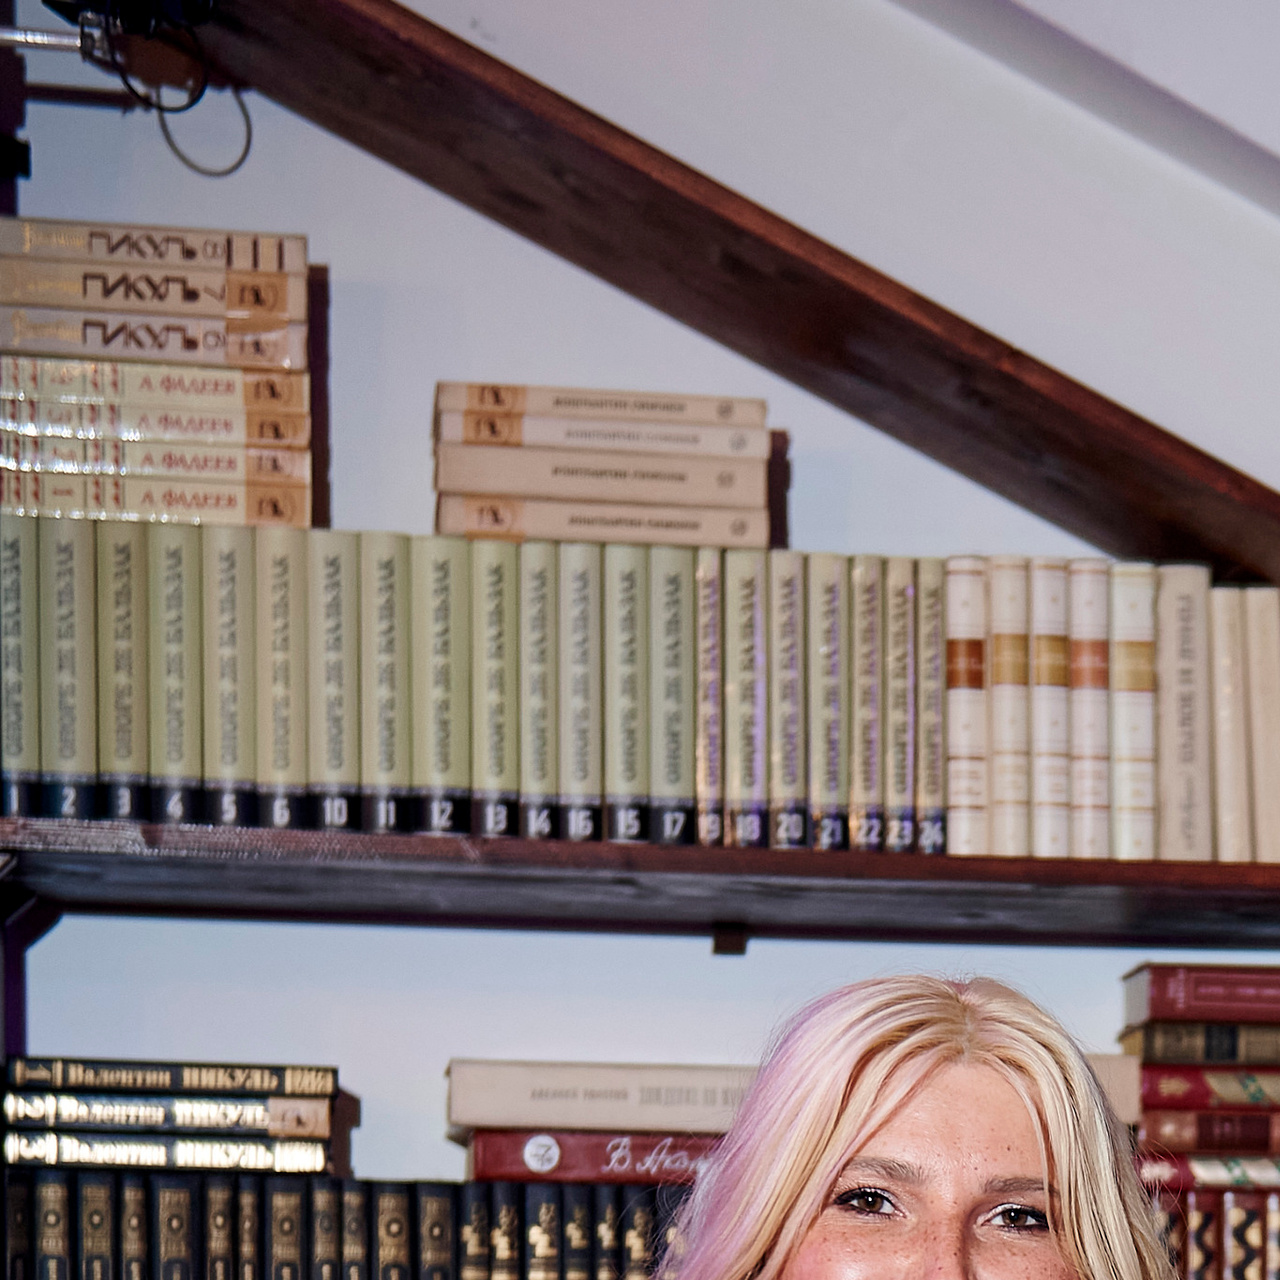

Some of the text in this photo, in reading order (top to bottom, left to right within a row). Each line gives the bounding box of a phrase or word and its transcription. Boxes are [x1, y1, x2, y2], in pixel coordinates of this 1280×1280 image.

[82, 271, 200, 301] ПИКУЛЬ
[82, 319, 200, 351] ПИКУЛЬ
[62, 785, 77, 817] 2
[117, 786, 132, 817] 3
[166, 790, 184, 820] 4
[221, 793, 238, 823] 5
[273, 797, 290, 827] 6
[323, 797, 348, 827] 10
[377, 800, 396, 830] 11
[430, 800, 454, 830] 12
[485, 803, 508, 834] 13
[528, 807, 552, 838] 14
[617, 808, 641, 838] 15
[662, 810, 686, 840] 17
